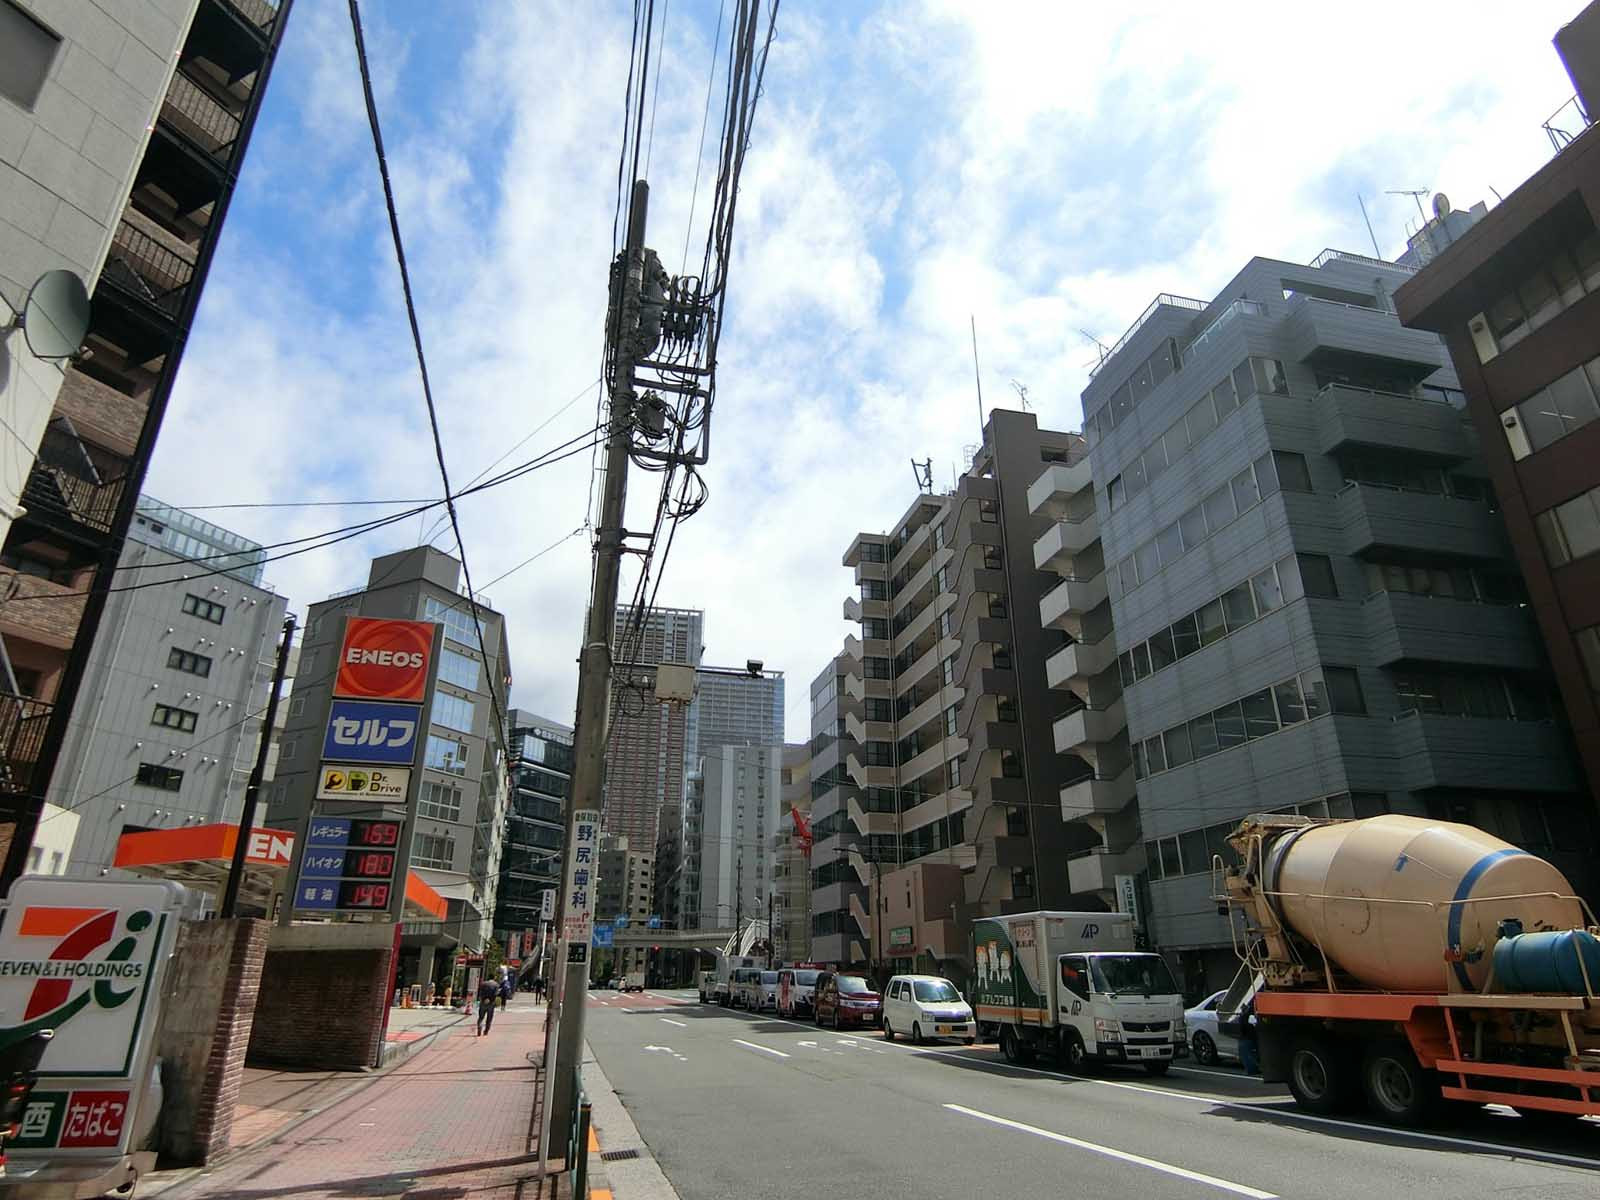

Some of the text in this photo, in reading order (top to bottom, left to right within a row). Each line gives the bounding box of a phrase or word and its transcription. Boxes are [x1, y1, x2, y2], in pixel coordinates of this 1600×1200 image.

[346, 648, 424, 668] ENEOS
[332, 716, 416, 748] セルフ
[371, 771, 388, 783] Dr.
[370, 782, 402, 794] Drive
[311, 825, 350, 838] レギュラー
[363, 823, 398, 844] 169
[306, 856, 344, 869] ハイオク
[359, 854, 393, 875] 180
[571, 825, 593, 909] 野尻歯科
[304, 888, 334, 900] 軽油
[353, 885, 388, 907] 149
[64, 963, 143, 978] HOLDINGS
[64, 1101, 124, 1138] たばこ
